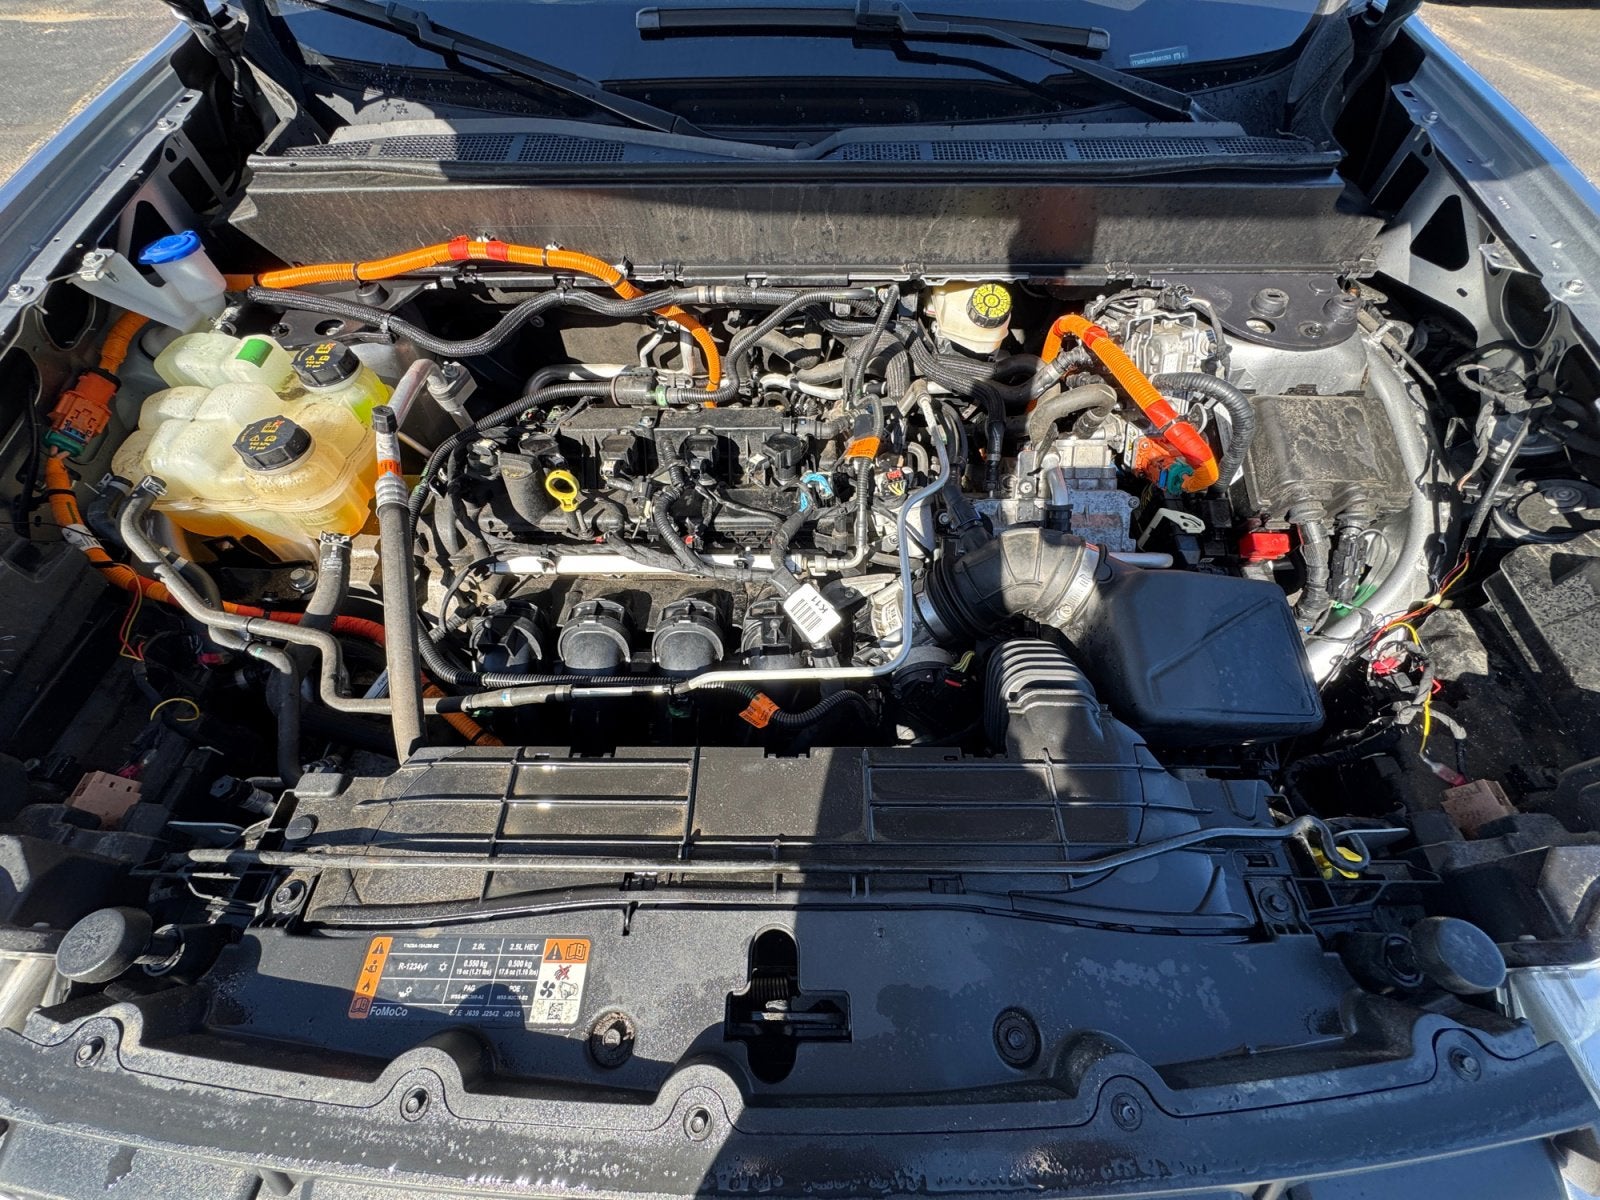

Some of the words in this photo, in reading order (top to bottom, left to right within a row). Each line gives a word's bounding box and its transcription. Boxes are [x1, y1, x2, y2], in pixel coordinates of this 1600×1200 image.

[810, 595, 829, 614] K11
[509, 943, 523, 951] 2.5L
[524, 943, 540, 951] HEV
[397, 962, 429, 973] R-1234yf
[480, 960, 489, 969] kg
[524, 960, 533, 969] kg
[463, 984, 476, 992] PAG
[369, 1005, 409, 1017] FoMoCo
